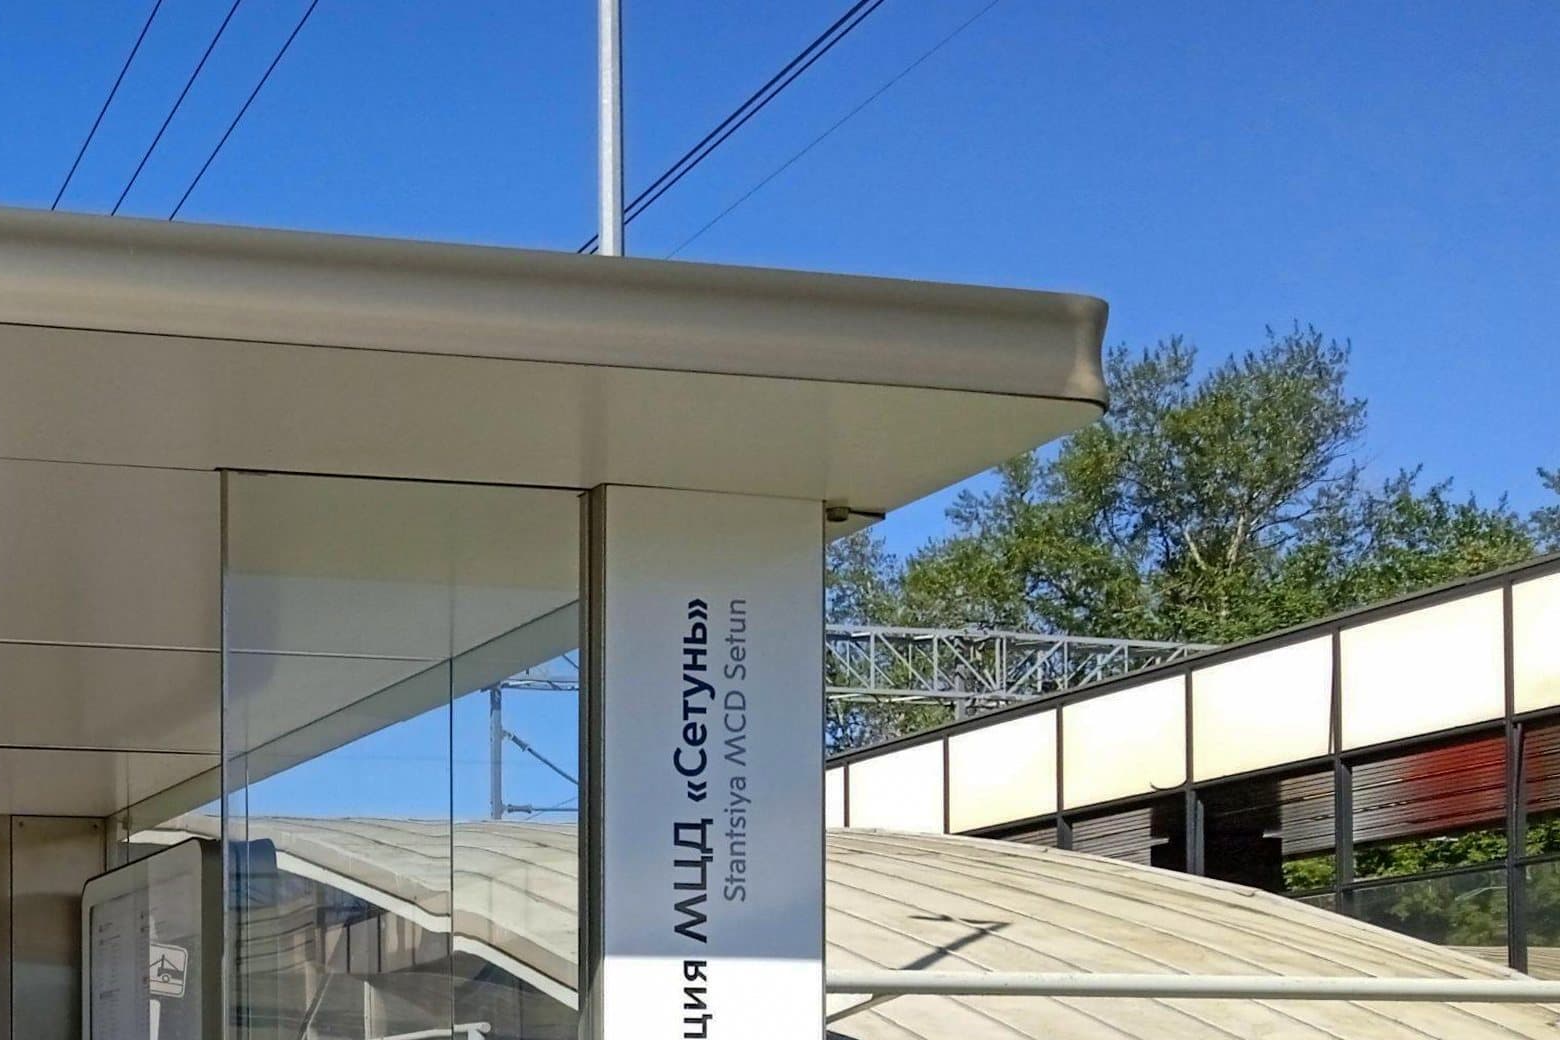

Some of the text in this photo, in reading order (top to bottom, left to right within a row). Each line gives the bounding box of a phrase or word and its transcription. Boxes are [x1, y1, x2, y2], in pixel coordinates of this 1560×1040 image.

[673, 598, 716, 802] «Сетунь»
[723, 599, 752, 902] Stantsiya MCD Setun
[673, 818, 714, 944] МЦД
